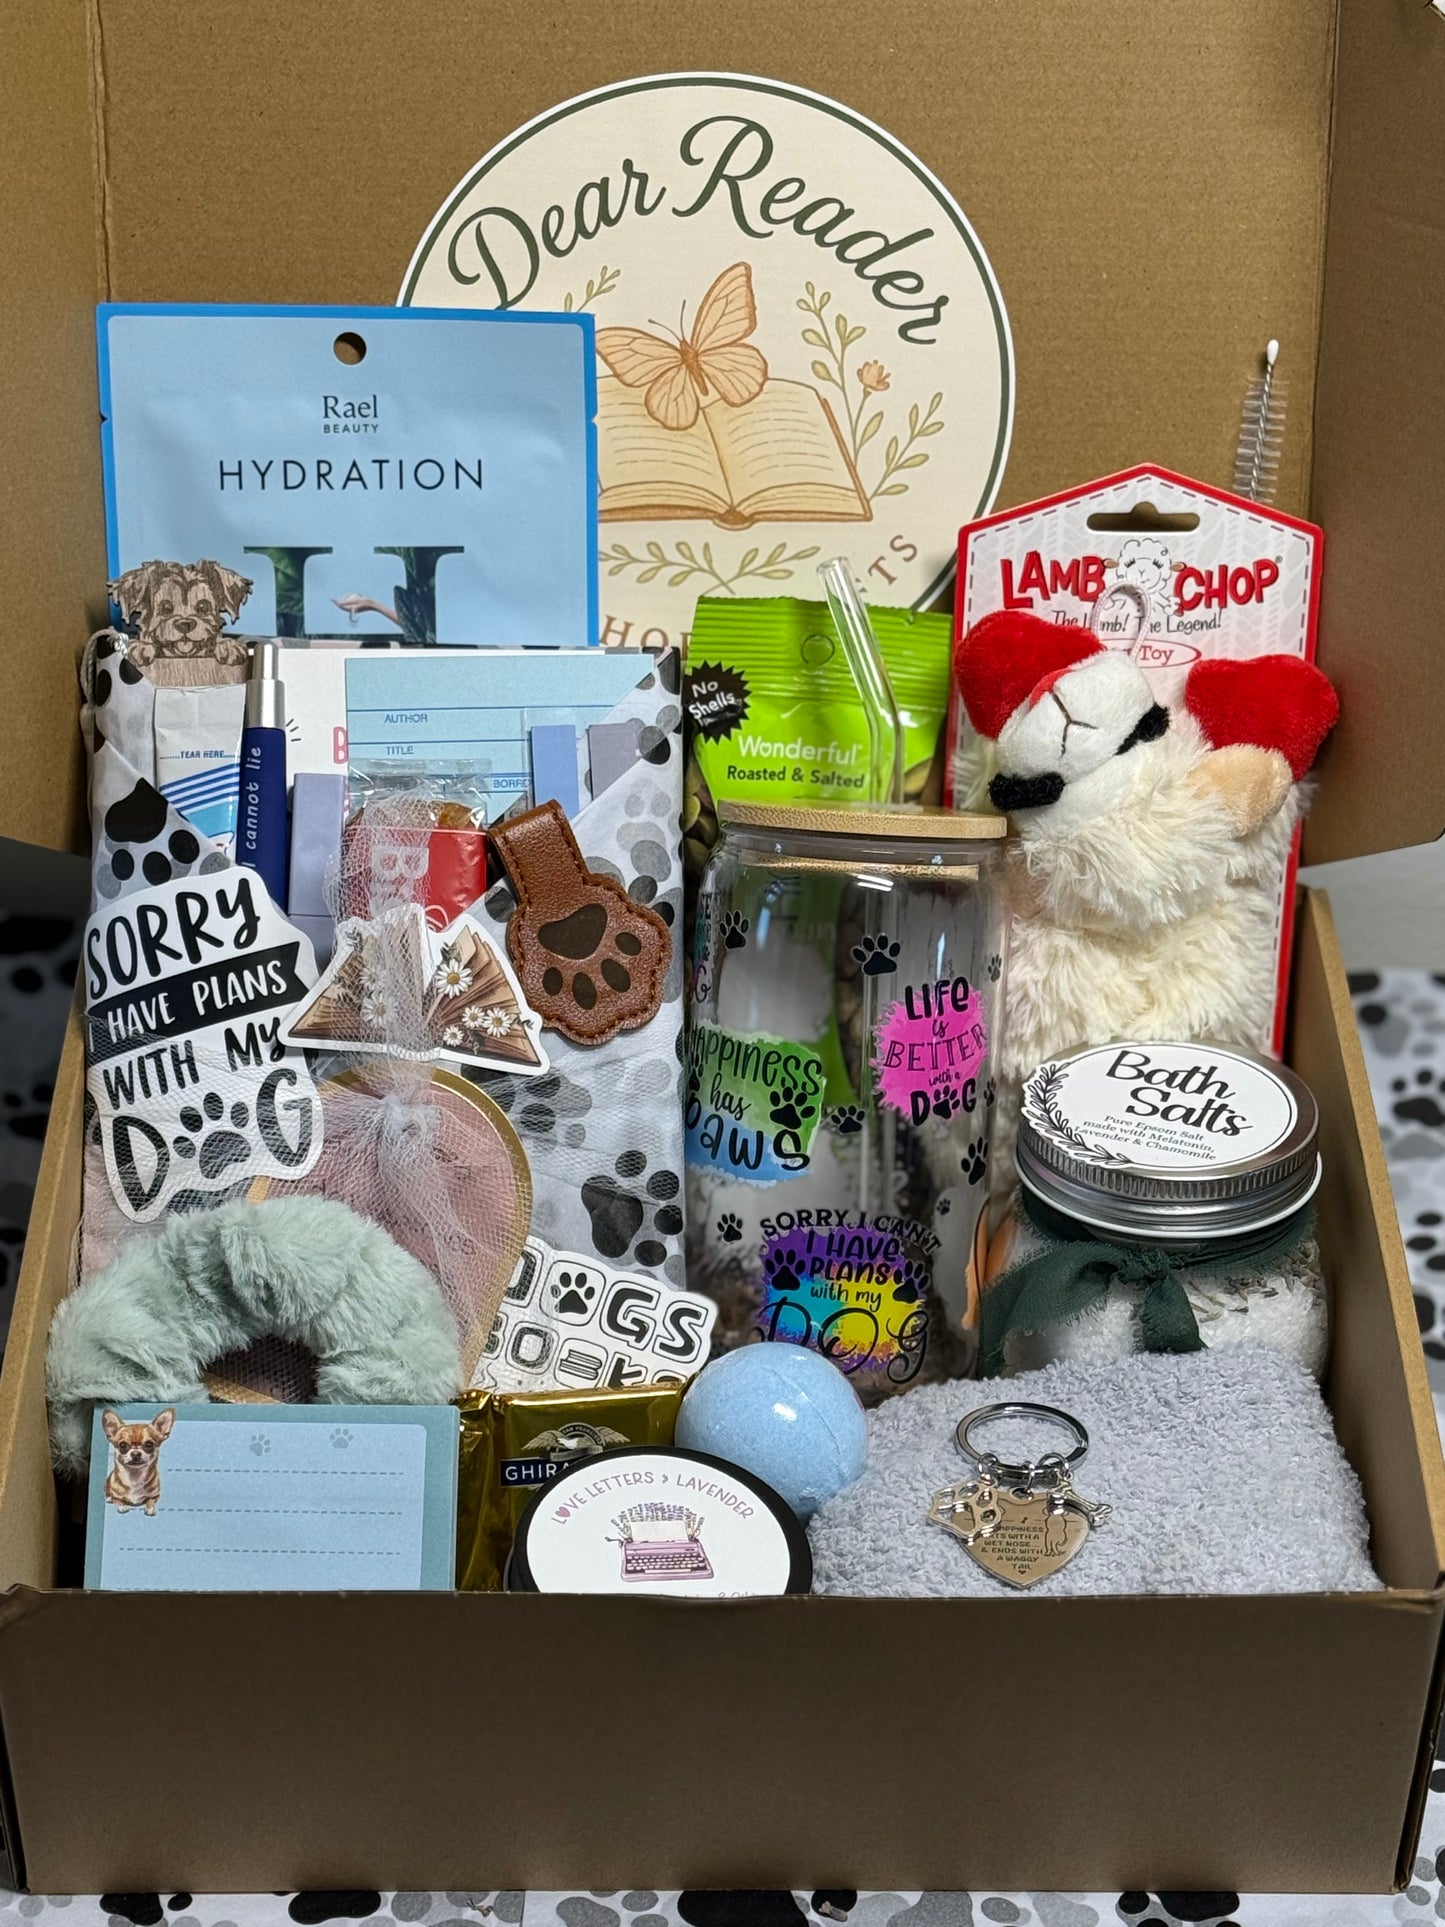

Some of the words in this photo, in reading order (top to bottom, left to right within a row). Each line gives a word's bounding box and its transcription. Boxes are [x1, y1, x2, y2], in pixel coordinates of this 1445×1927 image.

[448, 159, 666, 311] Dear
[672, 116, 949, 344] Reader
[323, 394, 379, 420] Rael
[324, 424, 379, 434] BEAUTY
[218, 459, 483, 491] HYDRATION
[1000, 550, 1106, 610] LAMB
[1173, 559, 1278, 612] CHOP
[1084, 613, 1130, 633] Lmb!
[1166, 608, 1222, 635] Legend!
[1140, 646, 1174, 665] Toy
[691, 681, 718, 698] No
[688, 692, 736, 719] Shells
[180, 751, 201, 759] TEAR
[203, 750, 224, 758] HERE
[246, 747, 261, 770] lie
[738, 735, 858, 765] Wonderful
[727, 765, 787, 782] Roasted
[791, 768, 804, 782] &
[811, 769, 865, 788] Salted
[246, 782, 259, 850] cannot
[107, 992, 175, 1043] HAVE
[192, 960, 287, 1016] PLANS
[883, 1024, 987, 1071] BETTER
[103, 1040, 199, 1110] WITH
[929, 1069, 952, 1086] with
[1106, 1050, 1236, 1100] Bath
[710, 1072, 752, 1121] has
[1125, 1086, 1253, 1137] Salts
[1074, 1126, 1130, 1143] Lavender
[1133, 1138, 1142, 1146] &
[1146, 1140, 1216, 1160] Chamomile
[1083, 1121, 1117, 1131] made
[1120, 1127, 1145, 1138] with
[1104, 1115, 1133, 1126] Pure
[1135, 1121, 1177, 1135] Epsom
[1180, 1131, 1204, 1142] Salt
[806, 1231, 815, 1253] I
[811, 1282, 848, 1302] with
[856, 1290, 881, 1312] my
[584, 1471, 654, 1498] LETTERS
[676, 1474, 754, 1519] LAVENDER
